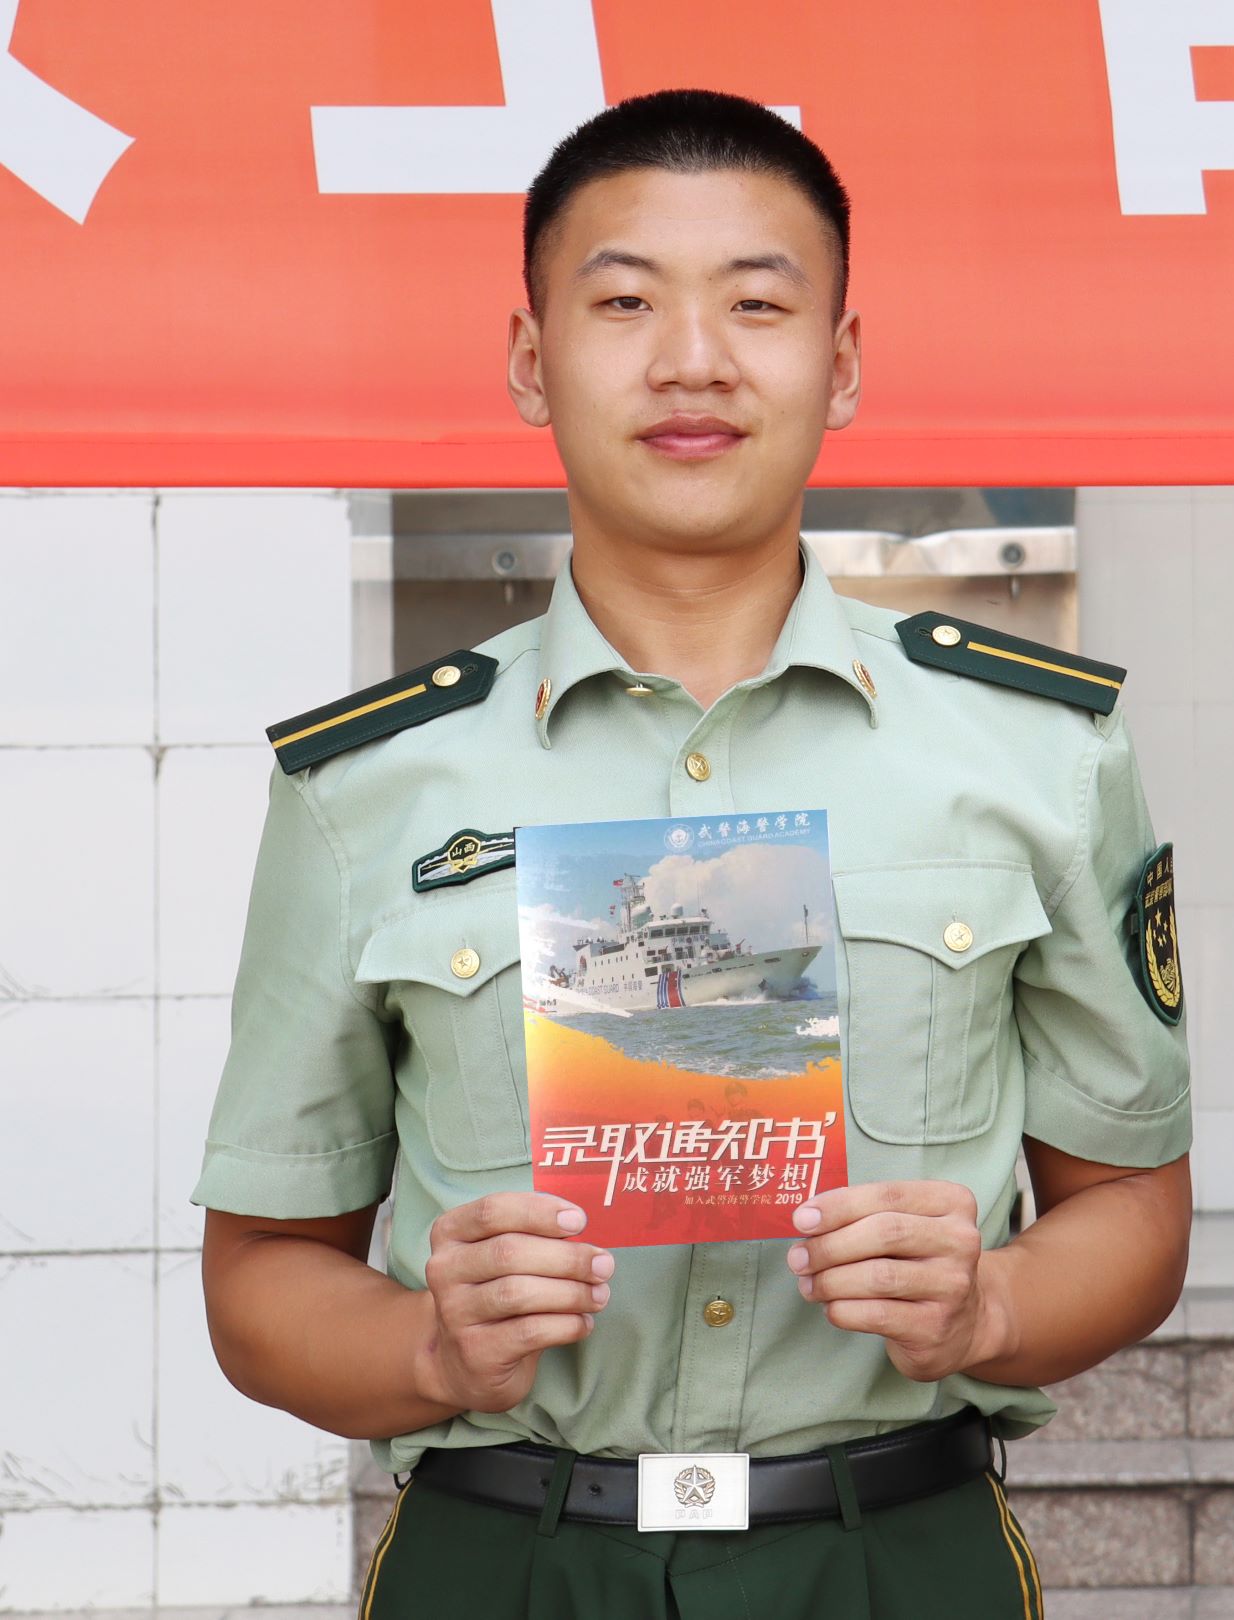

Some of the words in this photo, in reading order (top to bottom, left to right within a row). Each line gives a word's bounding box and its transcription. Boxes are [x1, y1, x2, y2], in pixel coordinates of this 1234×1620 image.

[697, 813, 810, 840] 武警海警学院
[452, 842, 475, 857] 山西
[621, 1163, 809, 1193] 成就强军梦想
[775, 1193, 803, 1205] 2019
